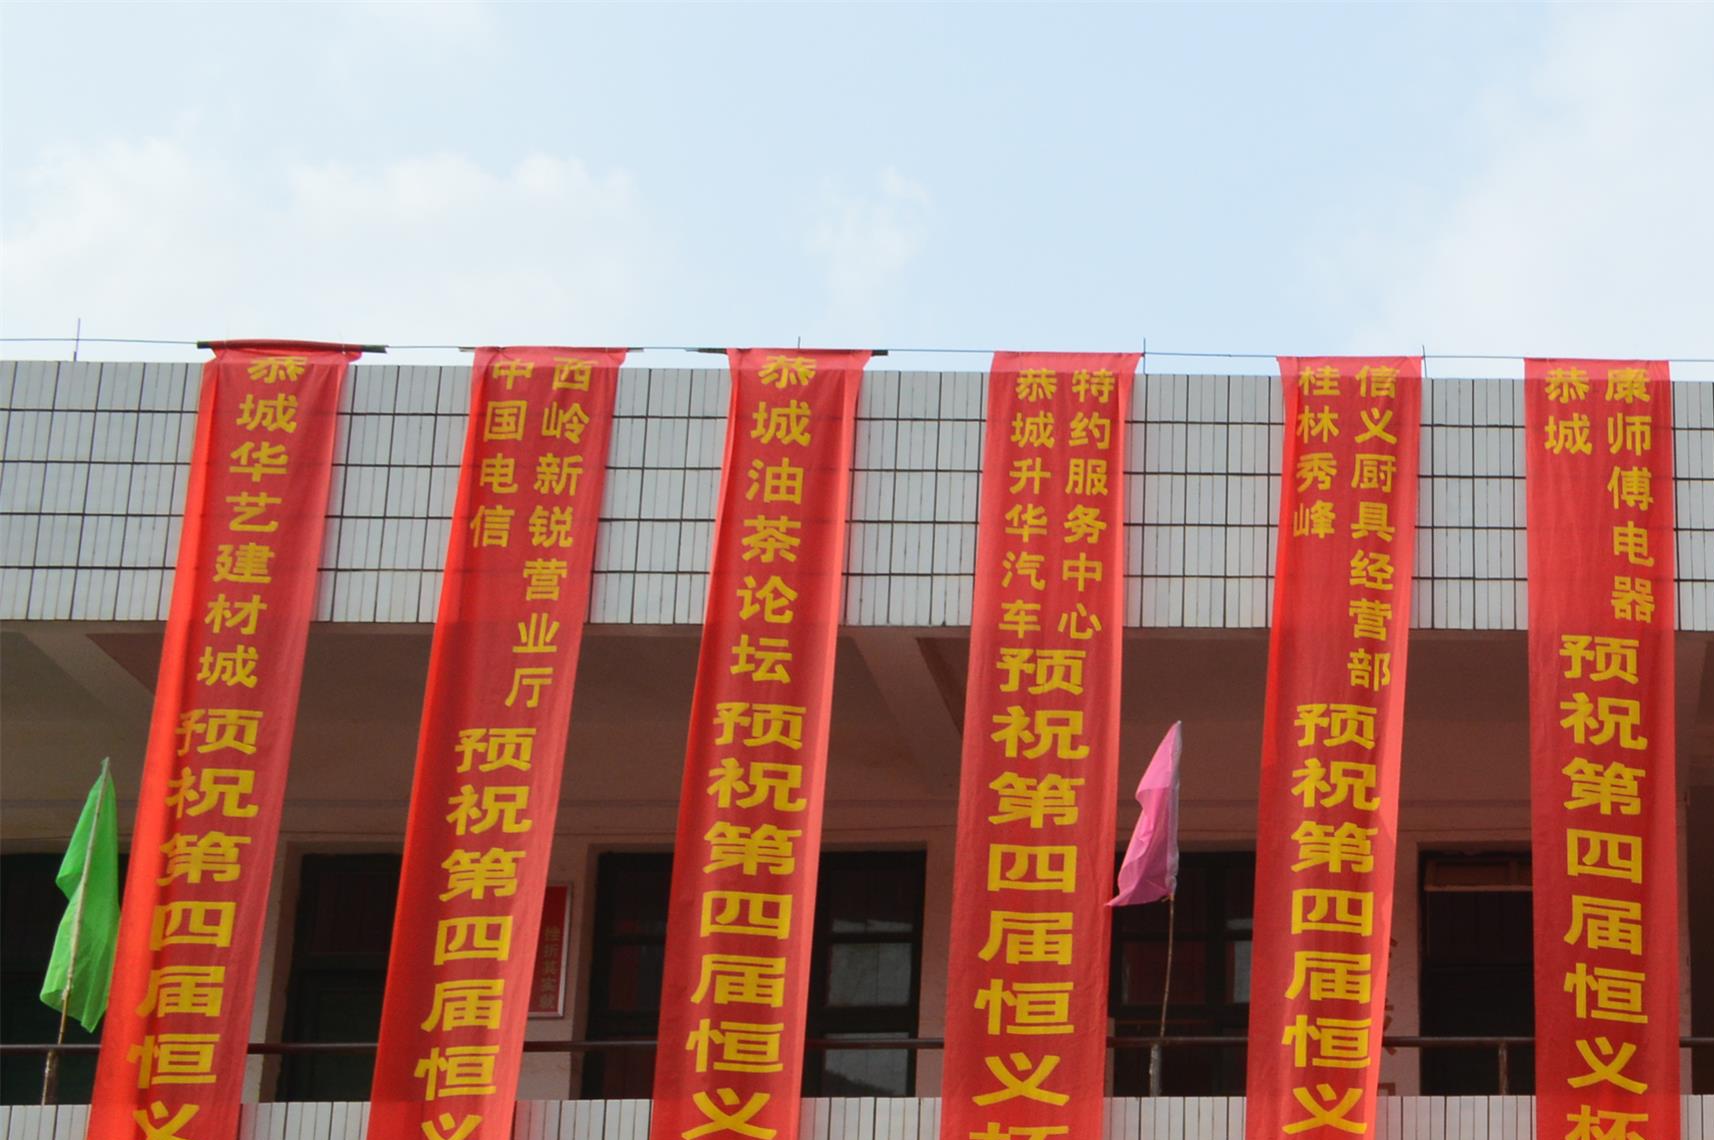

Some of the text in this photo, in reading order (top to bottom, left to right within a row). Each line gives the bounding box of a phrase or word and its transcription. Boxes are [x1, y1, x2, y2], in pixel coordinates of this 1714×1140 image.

[471, 361, 534, 547] 中国电信
[506, 356, 591, 708] 西岭新锐营业厅
[999, 369, 1056, 638] 恭城升华汽车
[1058, 370, 1114, 640] 特约服务中心
[1294, 367, 1340, 539] 桂林秀峰
[1347, 366, 1397, 691] 信义厨具经营部
[1545, 368, 1593, 454] 恭城
[1606, 368, 1655, 622] 康师傅电器
